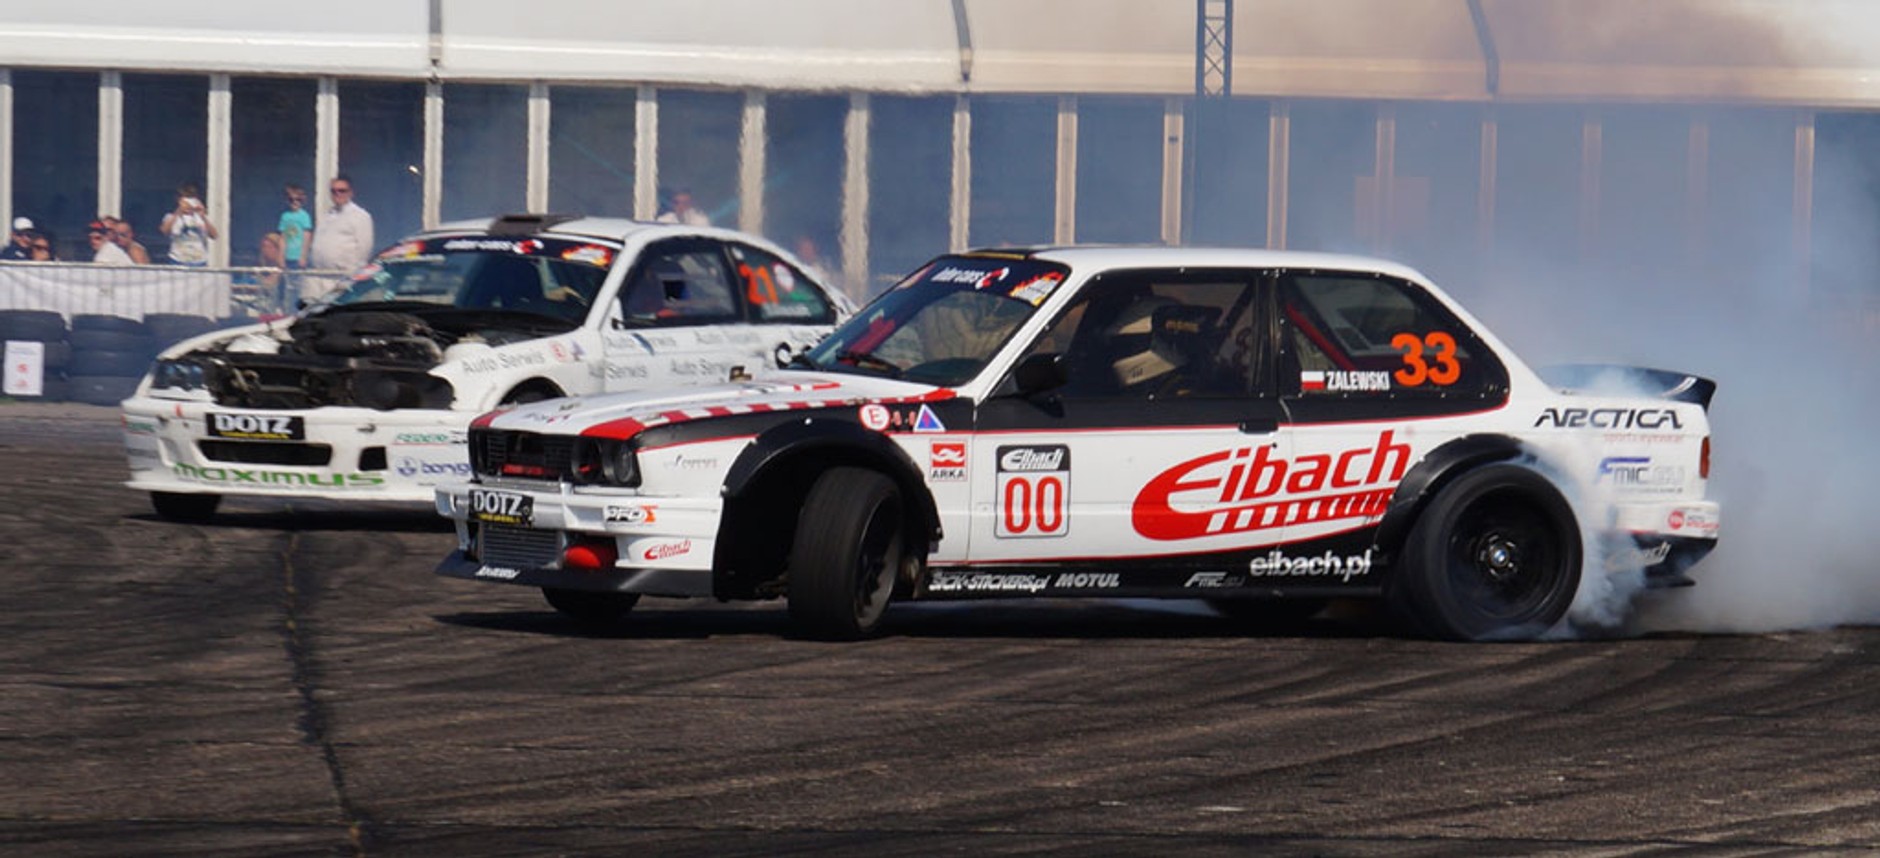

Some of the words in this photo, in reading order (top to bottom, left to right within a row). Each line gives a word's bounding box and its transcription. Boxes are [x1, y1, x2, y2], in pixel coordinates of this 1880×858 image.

[463, 357, 496, 373] Auto
[500, 348, 545, 370] Serwis
[1391, 331, 1461, 387] 33
[1326, 371, 1391, 391] ZALEWSKI
[214, 414, 293, 434] DOTZ
[869, 407, 882, 425] E
[1534, 408, 1683, 429] ARCTICA
[1003, 448, 1064, 471] Eibach
[932, 469, 965, 479] ARKA
[1131, 429, 1411, 540] Eibach
[474, 491, 522, 515] DOTZ
[1005, 477, 1062, 533] 00
[644, 539, 691, 560] Eibach
[1250, 550, 1371, 582] eibach.pl
[1055, 573, 1119, 588] MOTUL
